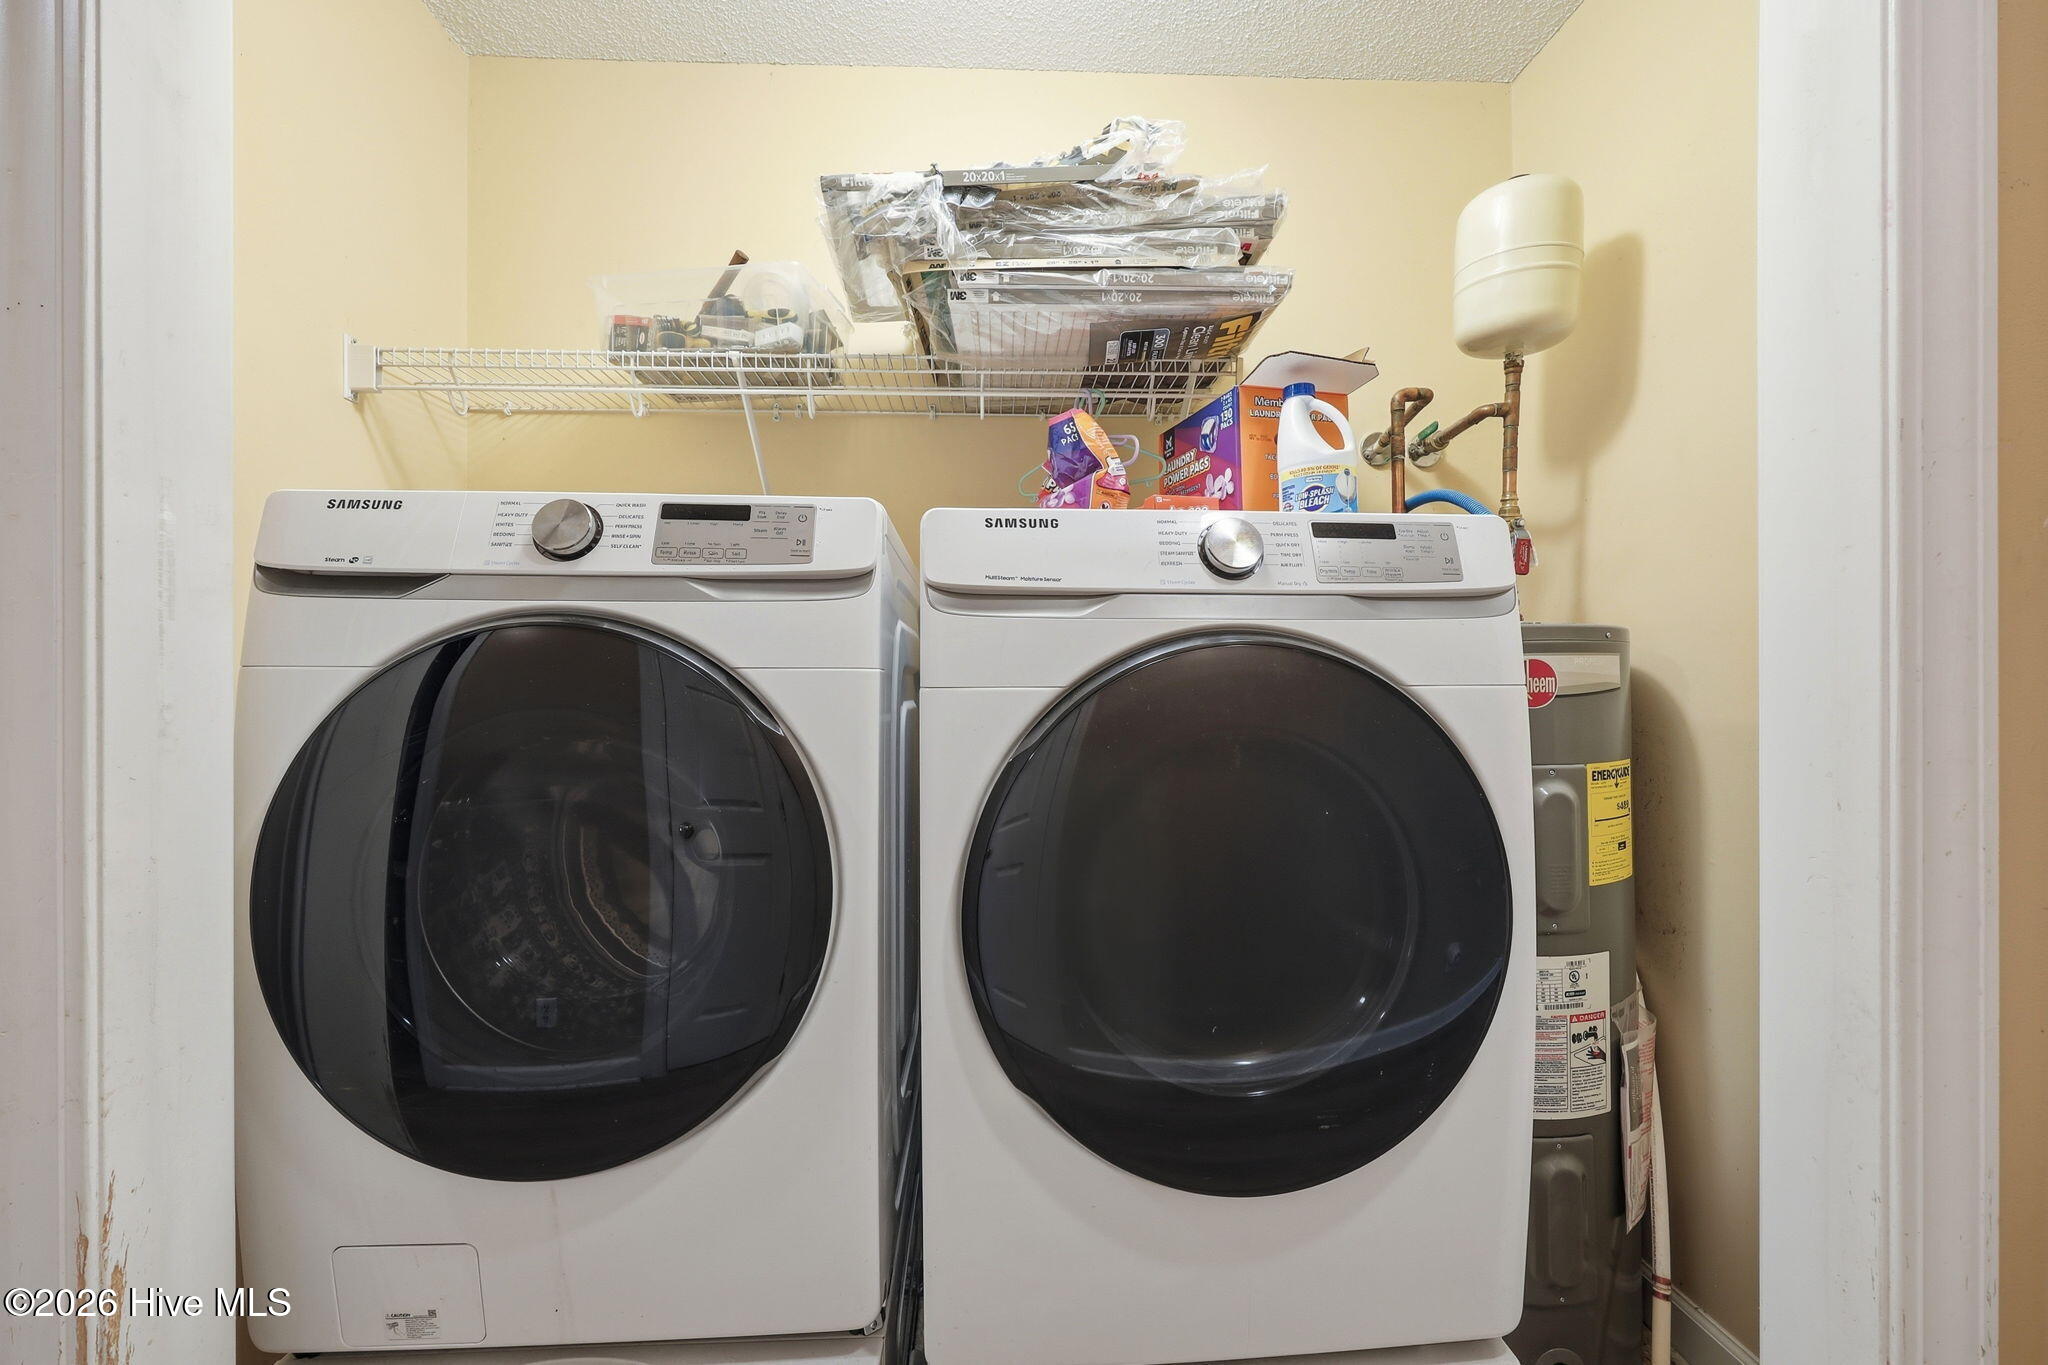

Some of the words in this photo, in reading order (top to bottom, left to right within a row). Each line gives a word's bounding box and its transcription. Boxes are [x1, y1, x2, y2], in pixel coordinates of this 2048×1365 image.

[962, 170, 1006, 183] 20x20x1
[1112, 273, 1154, 284] 20x20x1
[950, 291, 967, 301] 3M
[1101, 292, 1142, 303] 20x20x1
[1154, 334, 1166, 348] 300
[1187, 326, 1206, 347] Clean
[1220, 408, 1234, 422] 130
[1063, 422, 1077, 436] 65
[1163, 467, 1190, 489] POWER
[1189, 455, 1211, 477] PACS
[326, 498, 403, 510] SAMSUNG
[1299, 495, 1331, 509] BLEACH
[984, 517, 1059, 529] SAMSUNG
